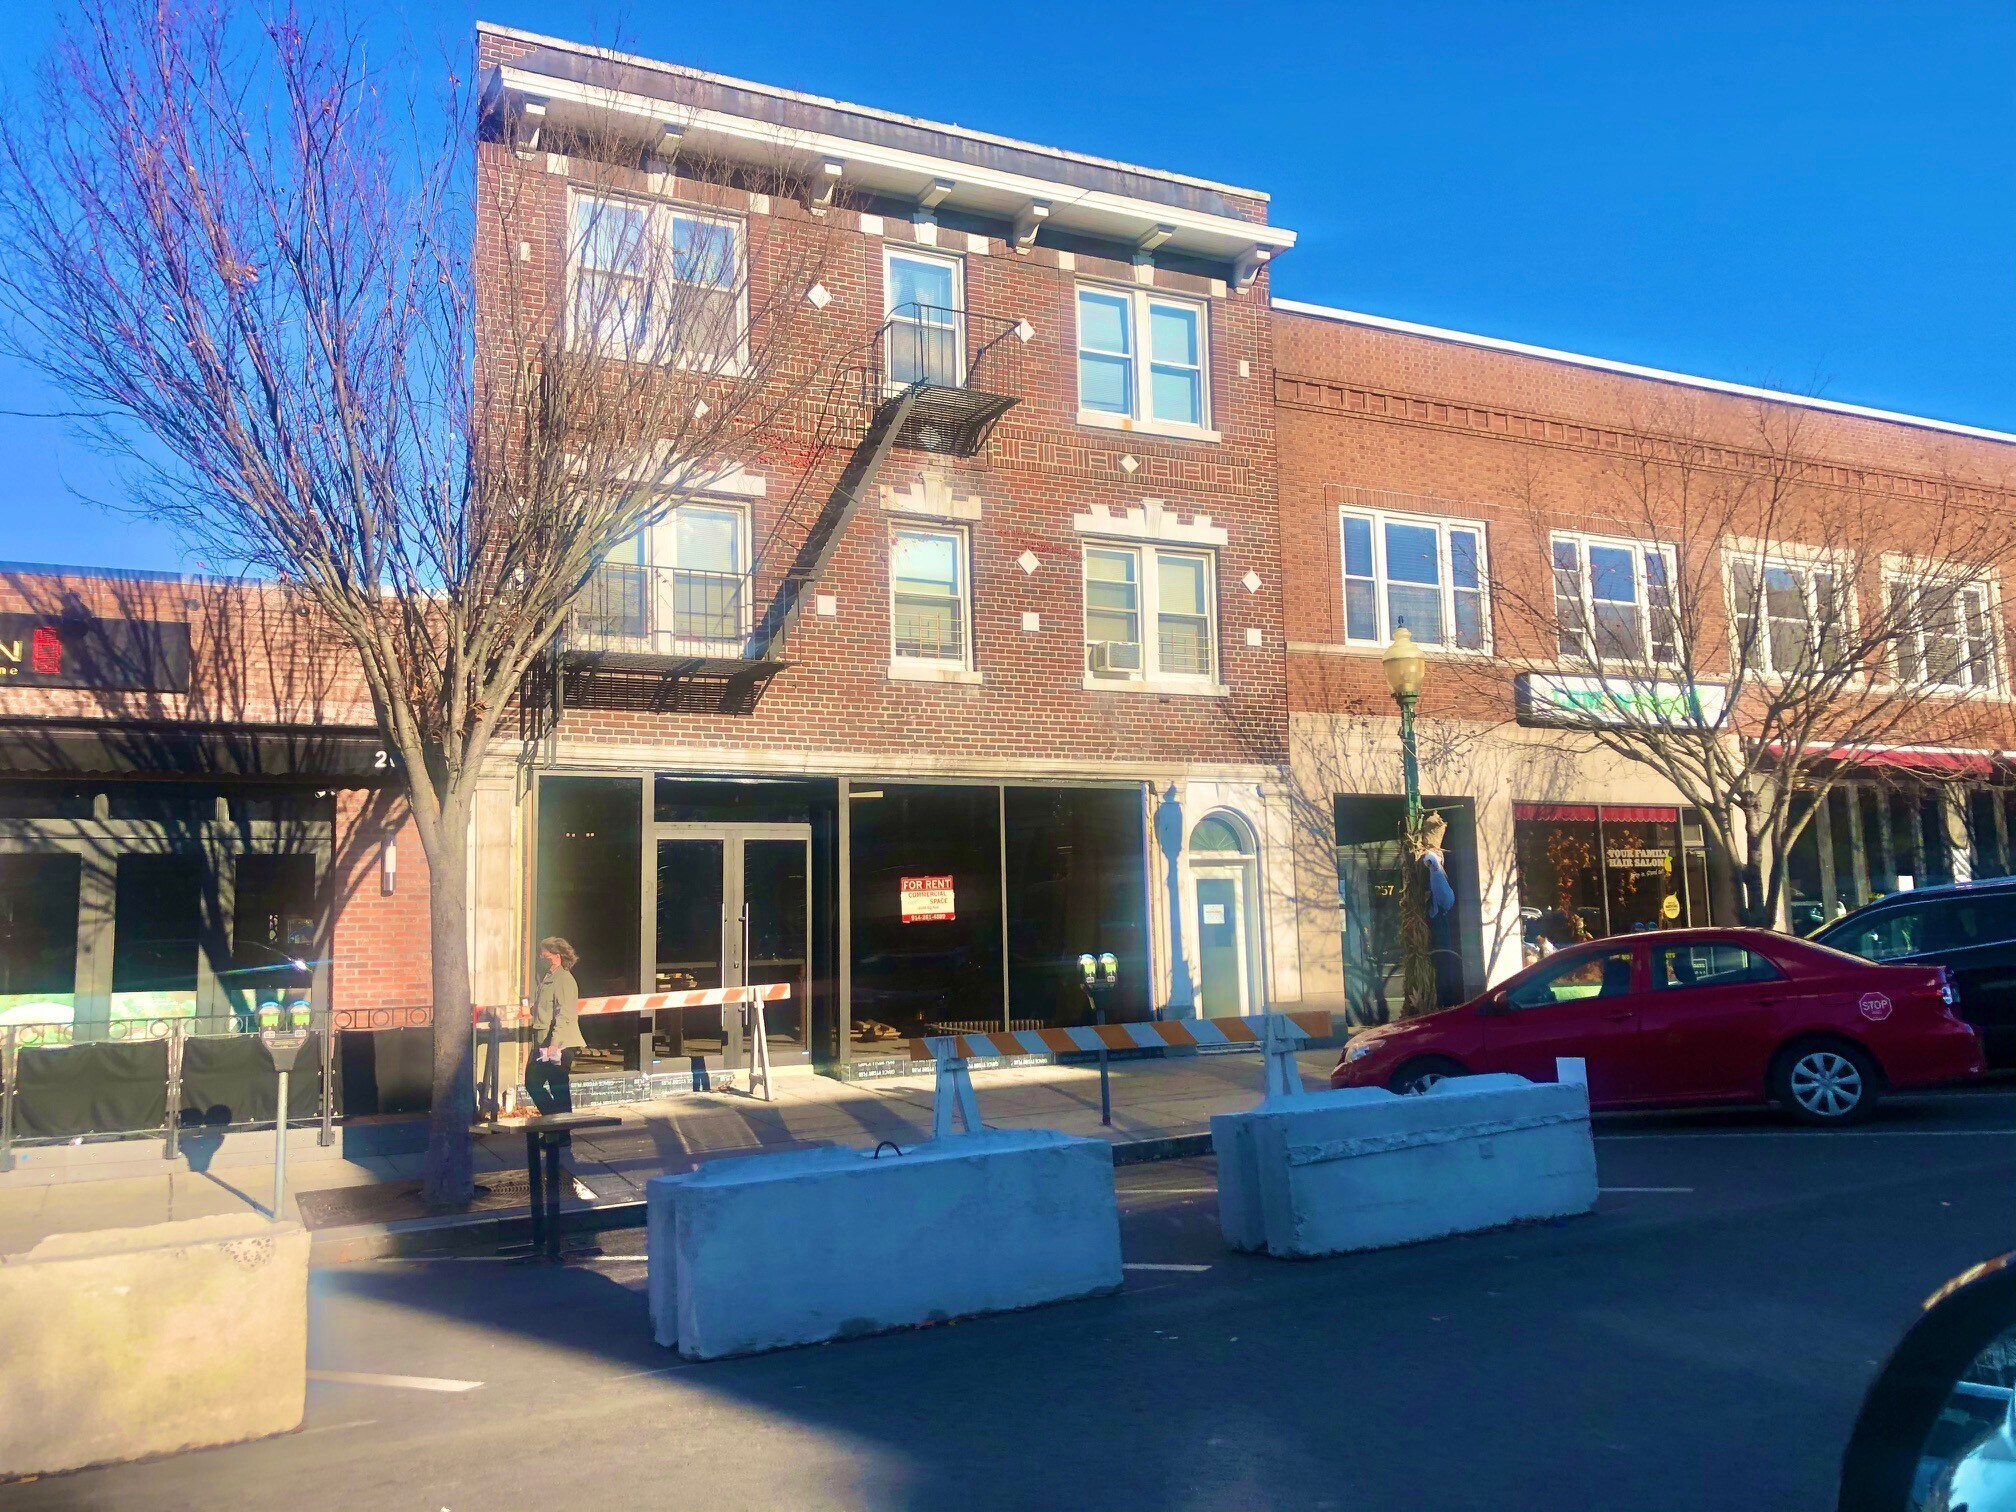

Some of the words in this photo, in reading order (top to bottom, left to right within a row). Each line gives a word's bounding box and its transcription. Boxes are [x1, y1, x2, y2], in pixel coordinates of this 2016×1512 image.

[1607, 849, 1634, 858] YOUR
[1634, 849, 1670, 858] FAMILY
[1608, 858, 1634, 868] HAIR
[1634, 858, 1665, 868] SALON
[903, 880, 923, 890] FOR
[925, 879, 951, 889] RENT
[908, 891, 947, 899] COMMERCIAL
[1862, 1000, 1888, 1011] STOP
